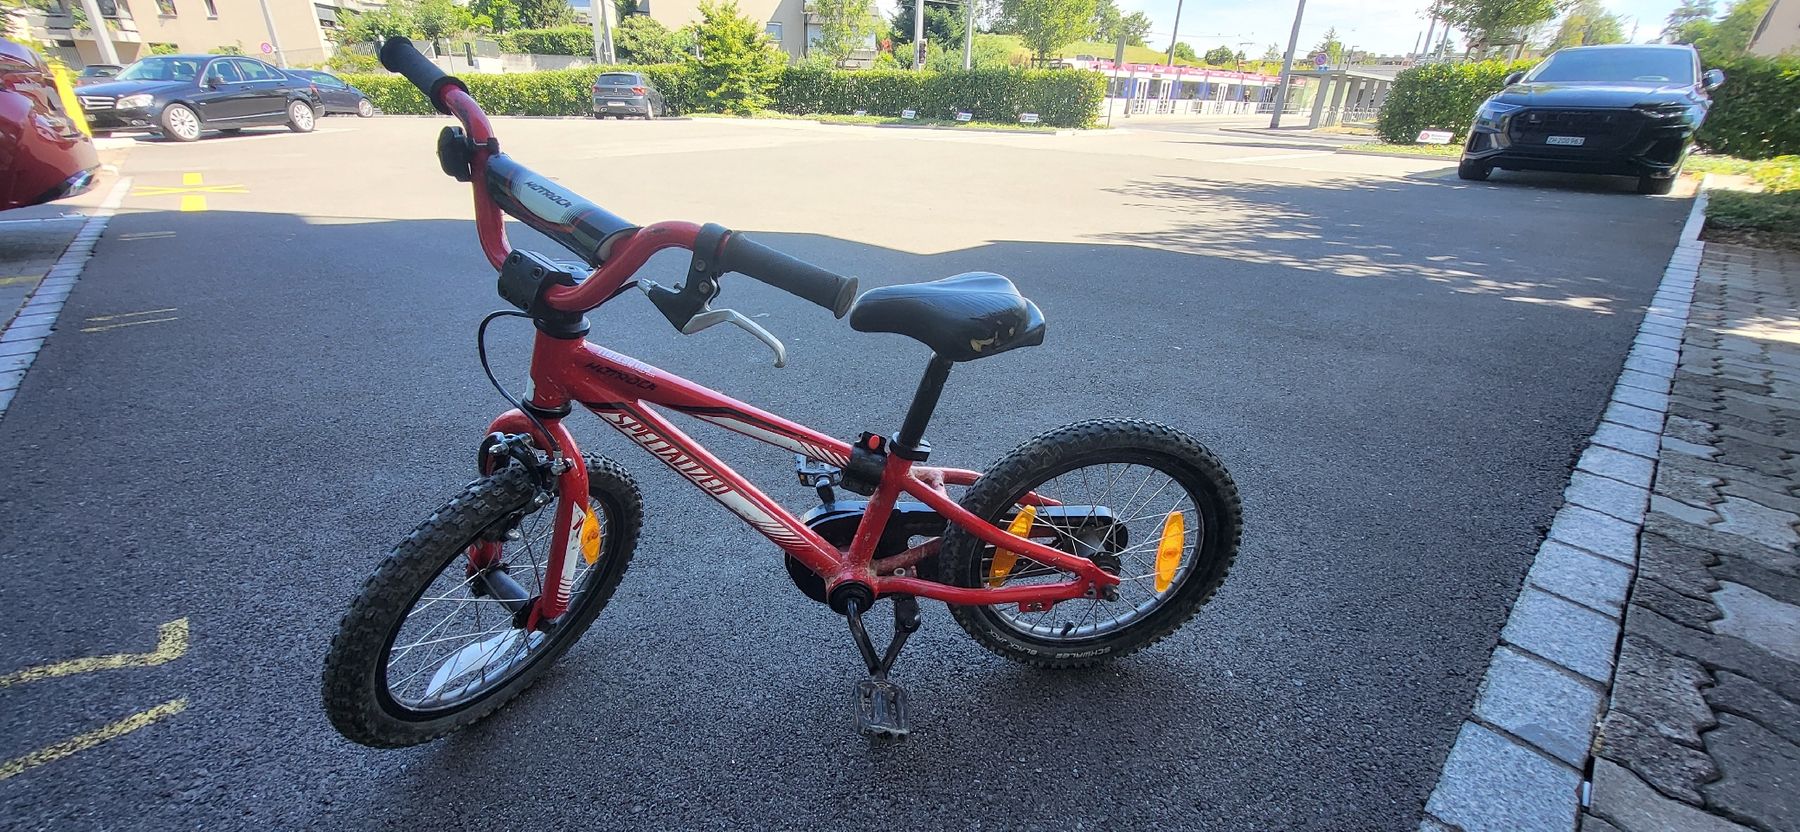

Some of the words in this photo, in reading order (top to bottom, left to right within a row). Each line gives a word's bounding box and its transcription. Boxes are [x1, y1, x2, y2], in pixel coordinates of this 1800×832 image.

[524, 181, 573, 208] HOTROCK
[584, 362, 658, 391] HOTROCK
[604, 413, 730, 496] SPECIALIZED
[987, 629, 1007, 643] JACK
[1008, 641, 1038, 655] BLACK
[1055, 646, 1112, 659] SCHWALBE
